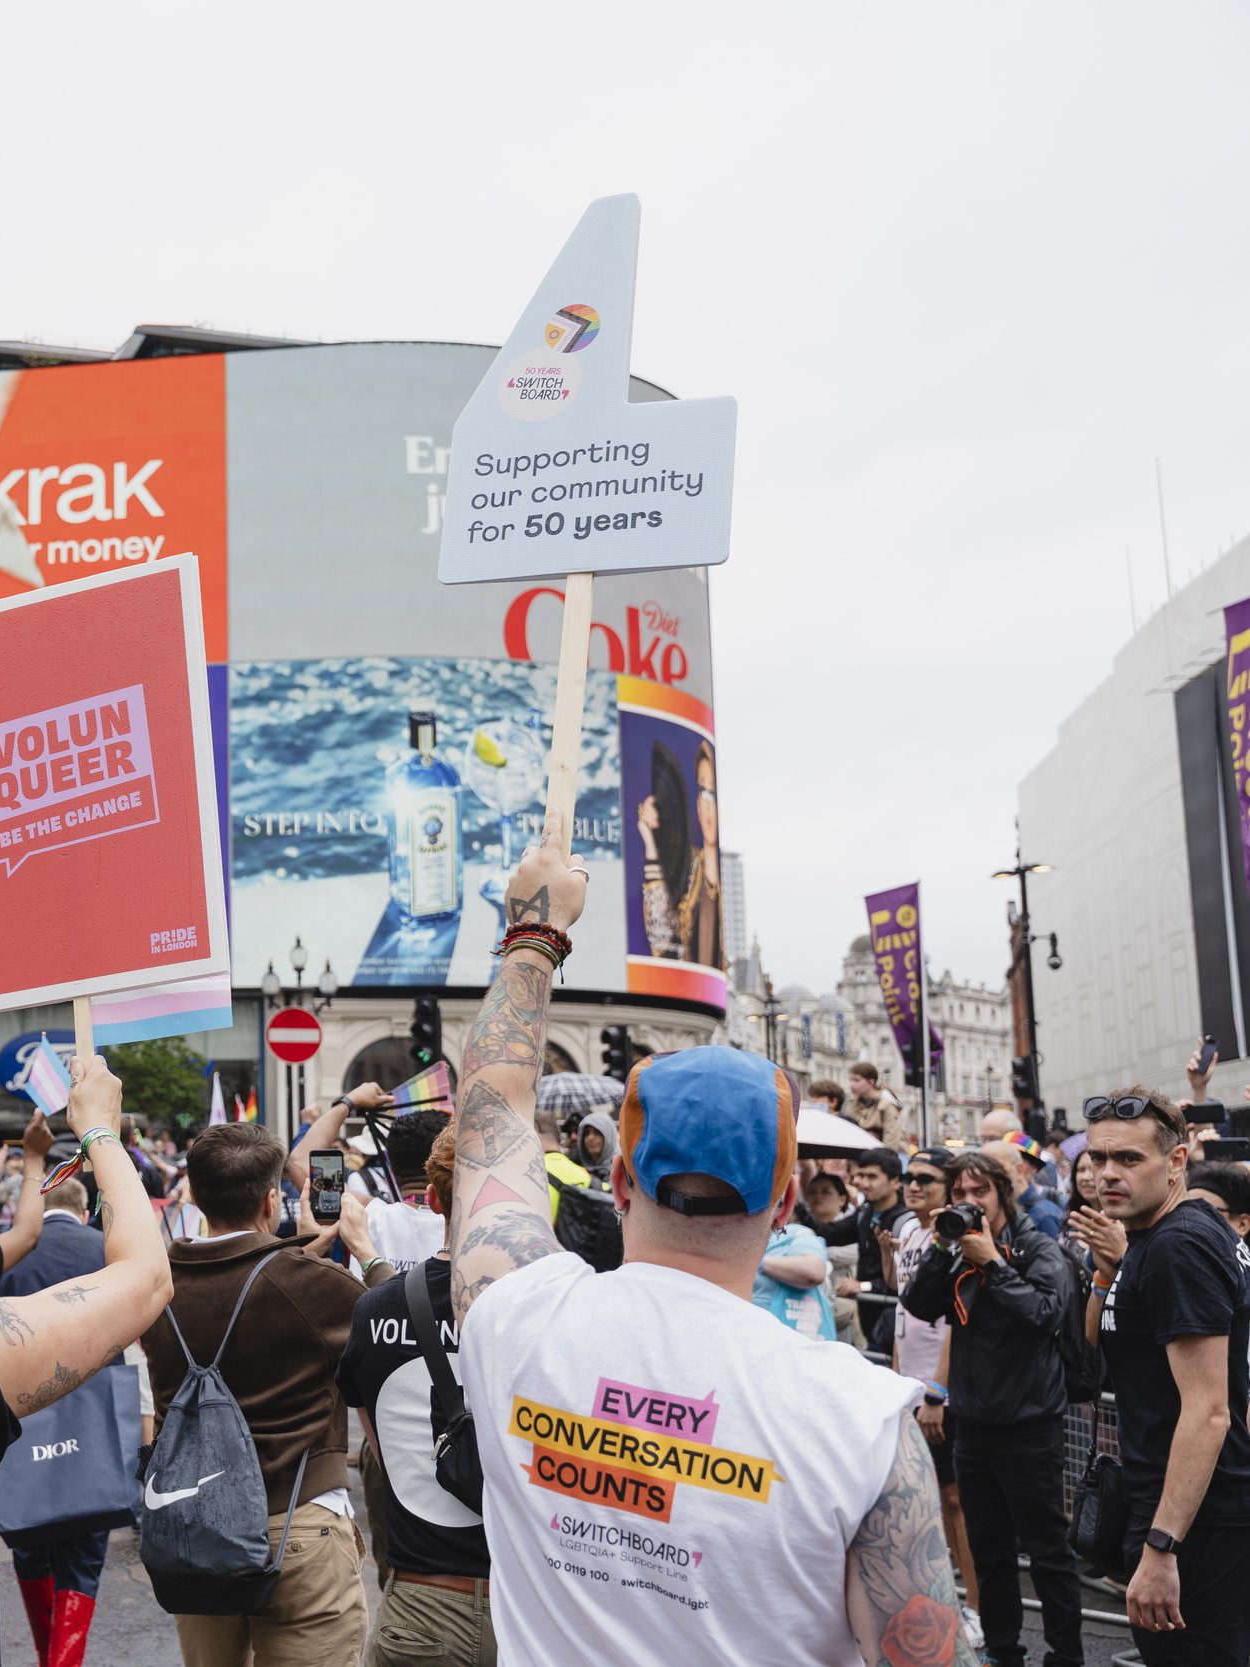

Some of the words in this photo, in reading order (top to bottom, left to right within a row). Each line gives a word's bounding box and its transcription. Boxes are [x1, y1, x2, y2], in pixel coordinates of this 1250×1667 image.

[516, 377, 563, 389] SWITCH
[524, 366, 536, 375] 50
[537, 367, 562, 375] YEARS
[520, 388, 561, 400] BOARD
[474, 440, 650, 479] Supporting
[471, 488, 523, 510] our
[531, 469, 704, 503] community
[467, 520, 515, 543] for
[524, 512, 565, 538] 50
[573, 510, 664, 540] years
[47, 535, 165, 564] money
[642, 600, 681, 637] Diet
[0, 827, 24, 848] BE
[25, 815, 62, 839] THE
[64, 791, 143, 827] CHANGE
[244, 811, 311, 837] STEP
[151, 945, 161, 954] IN
[162, 939, 198, 952] LONDON
[601, 1386, 710, 1434] EVERY
[31, 1438, 80, 1461] DIOR
[516, 1406, 764, 1493] CONVERSATION
[537, 1455, 666, 1513] COUNTS
[559, 1537, 617, 1560] LGBTQIA+
[619, 1551, 664, 1574] Support
[666, 1567, 688, 1582] Line
[561, 1516, 690, 1567] SWITCHBOARD
[564, 1562, 587, 1577] 0119
[590, 1569, 610, 1582] 100
[620, 1577, 710, 1611] switchboard.lgbt
